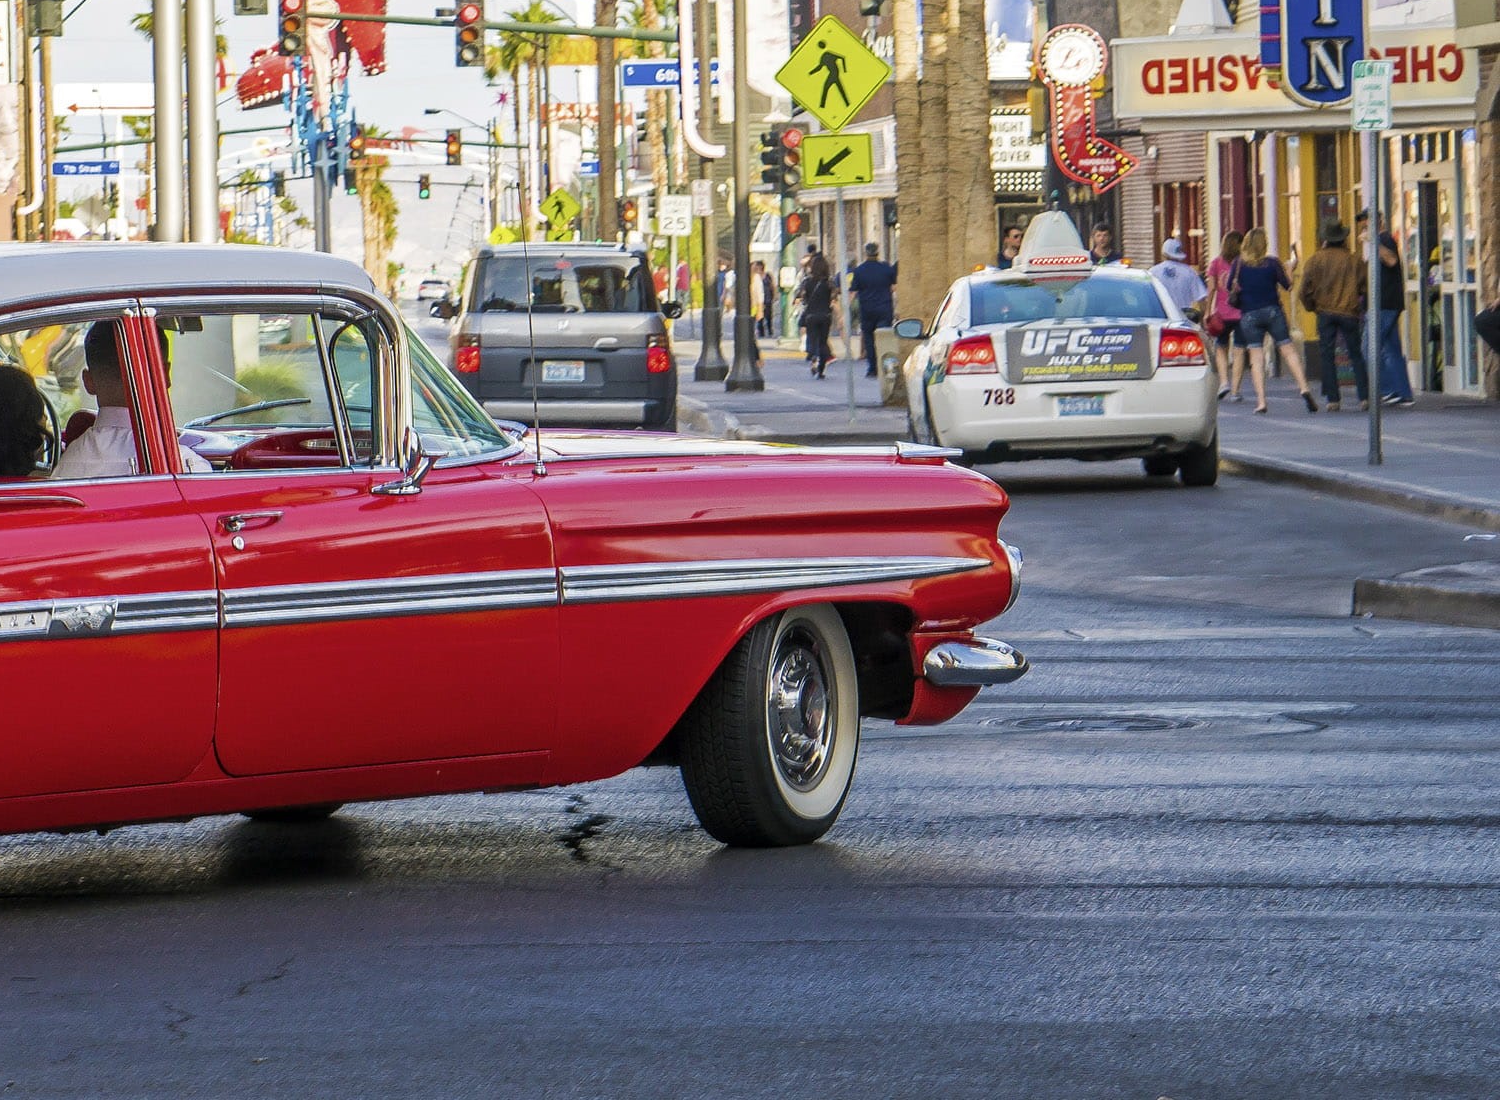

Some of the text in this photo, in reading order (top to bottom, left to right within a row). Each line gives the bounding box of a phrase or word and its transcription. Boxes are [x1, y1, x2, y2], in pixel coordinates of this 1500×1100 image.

[662, 216, 687, 230] 25
[1020, 327, 1092, 357] UFC
[1046, 355, 1080, 367] JULY
[983, 387, 1016, 406] 788
